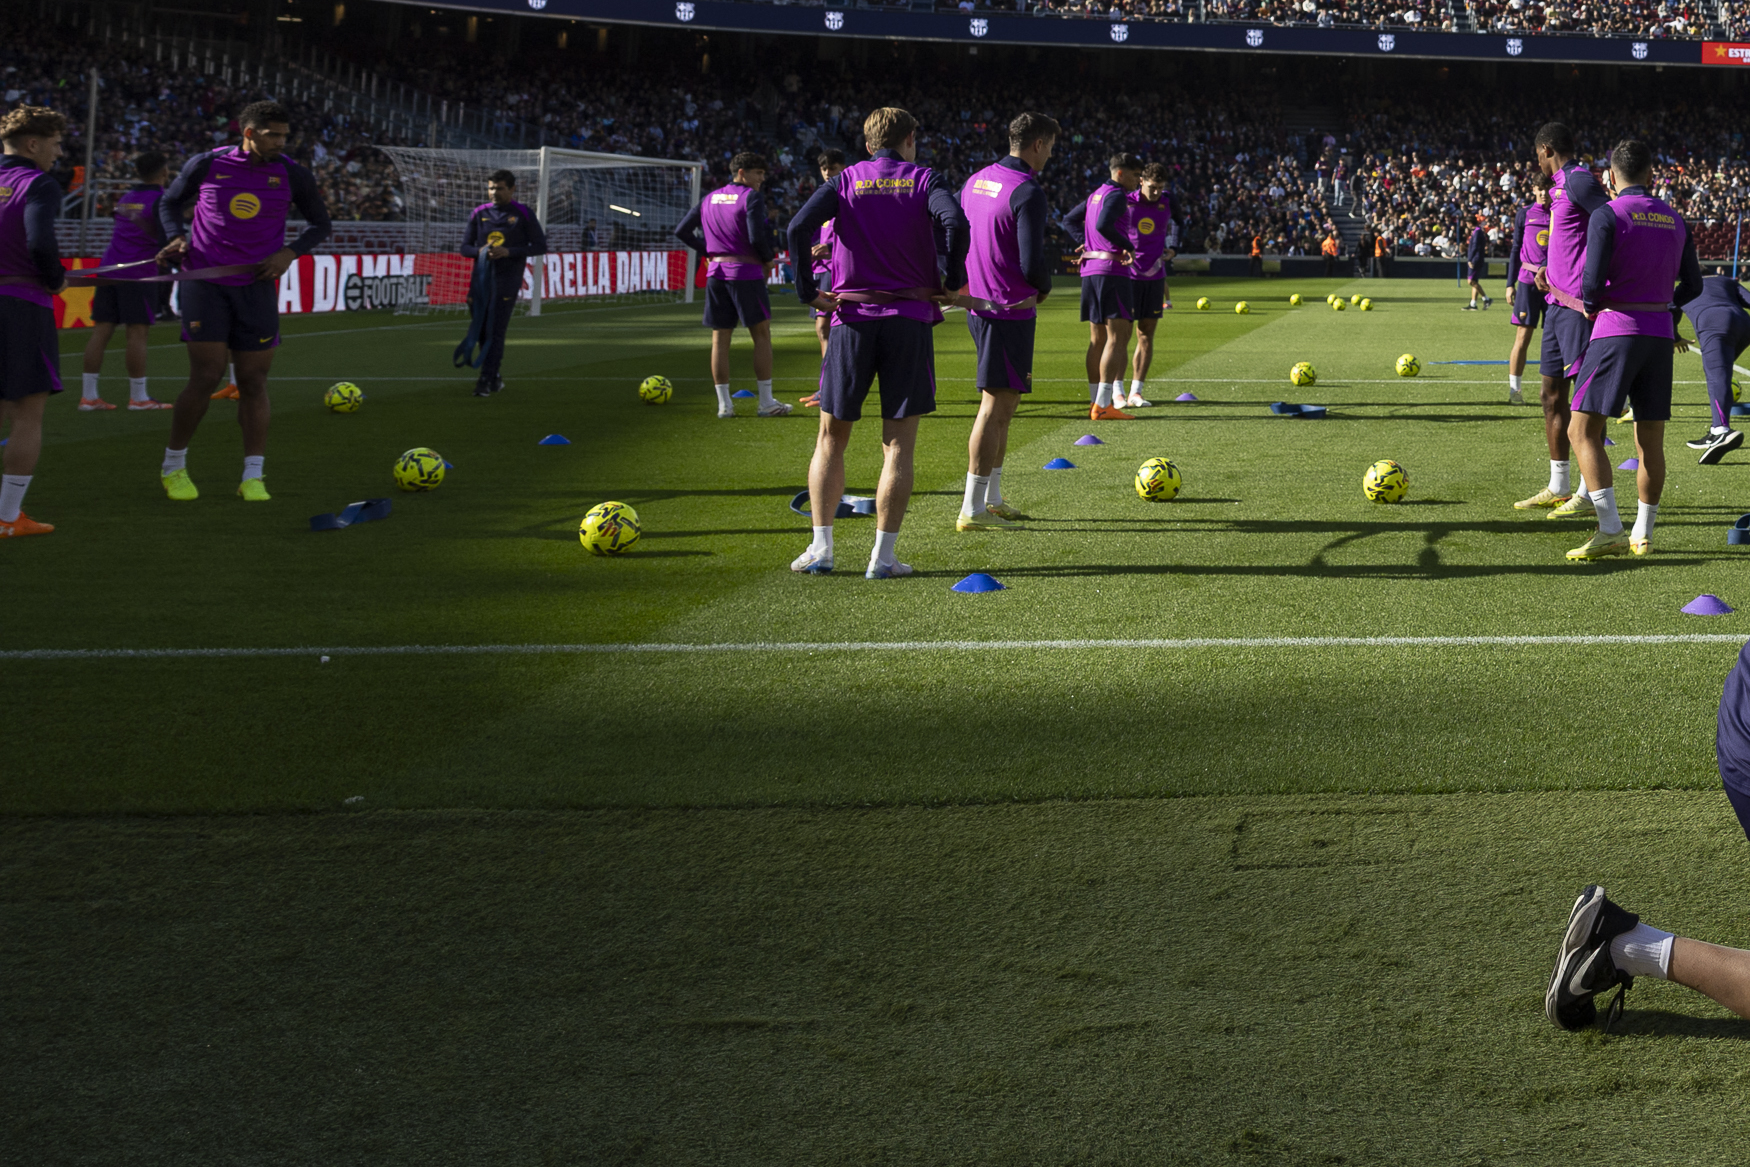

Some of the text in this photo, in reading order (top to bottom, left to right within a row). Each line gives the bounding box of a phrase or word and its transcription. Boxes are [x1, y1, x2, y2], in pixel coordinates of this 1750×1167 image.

[876, 178, 915, 189] CONGO
[1648, 213, 1675, 224] CONGO
[616, 251, 669, 294] DAMM
